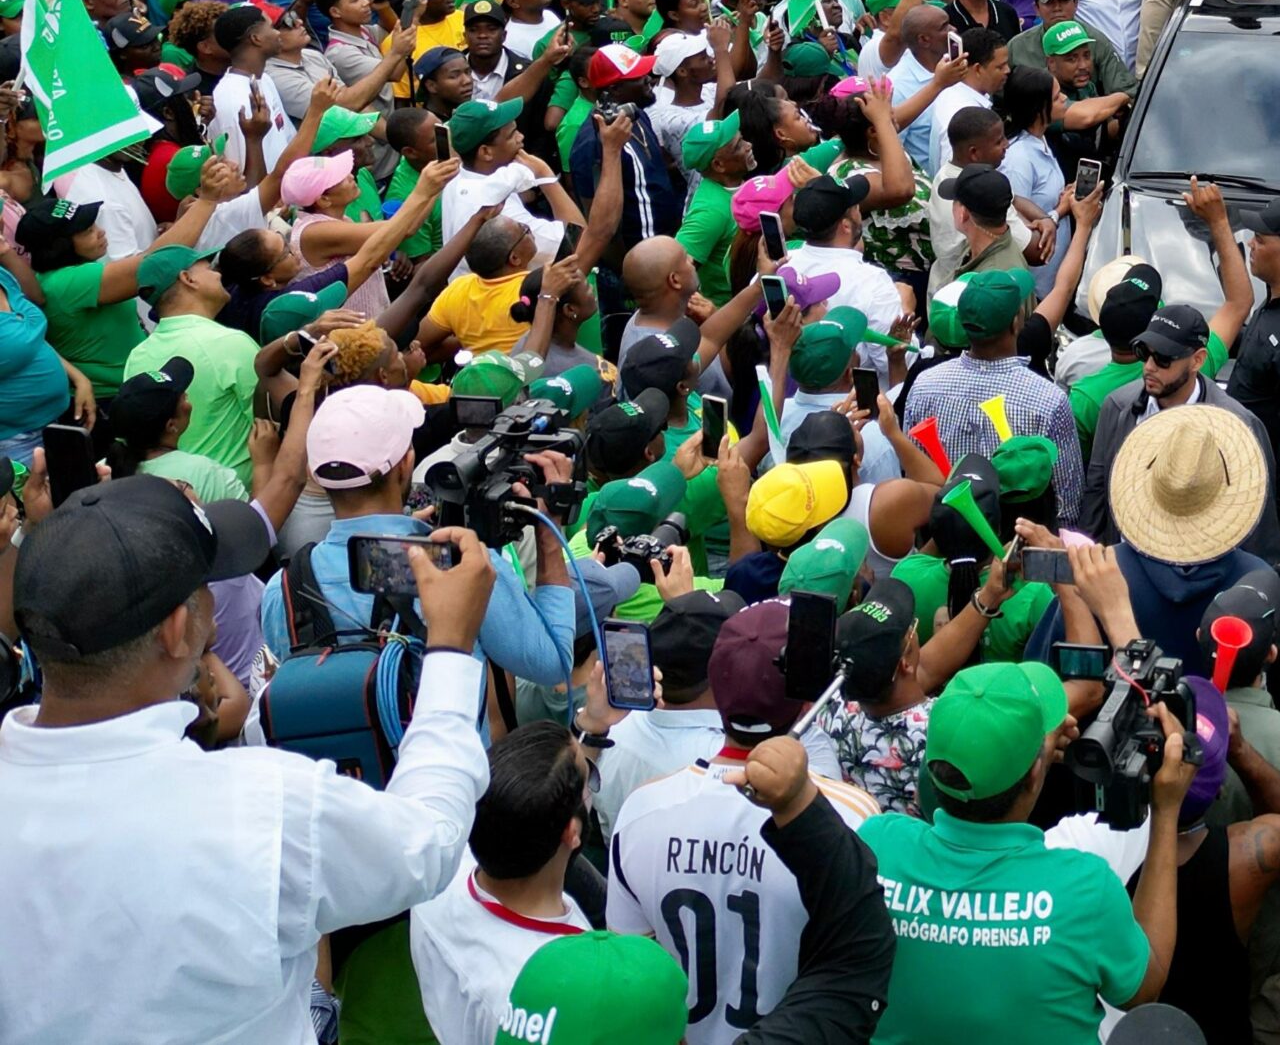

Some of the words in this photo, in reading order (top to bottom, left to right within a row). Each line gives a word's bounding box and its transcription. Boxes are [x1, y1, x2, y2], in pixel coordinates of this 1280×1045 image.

[667, 835, 766, 883] RINCÓN
[941, 891, 1053, 921] VALLEJO
[892, 916, 969, 946] ARÓGRAFO
[972, 927, 1029, 947] PRENSA
[1034, 925, 1051, 946] FP
[660, 888, 766, 1029] 01
